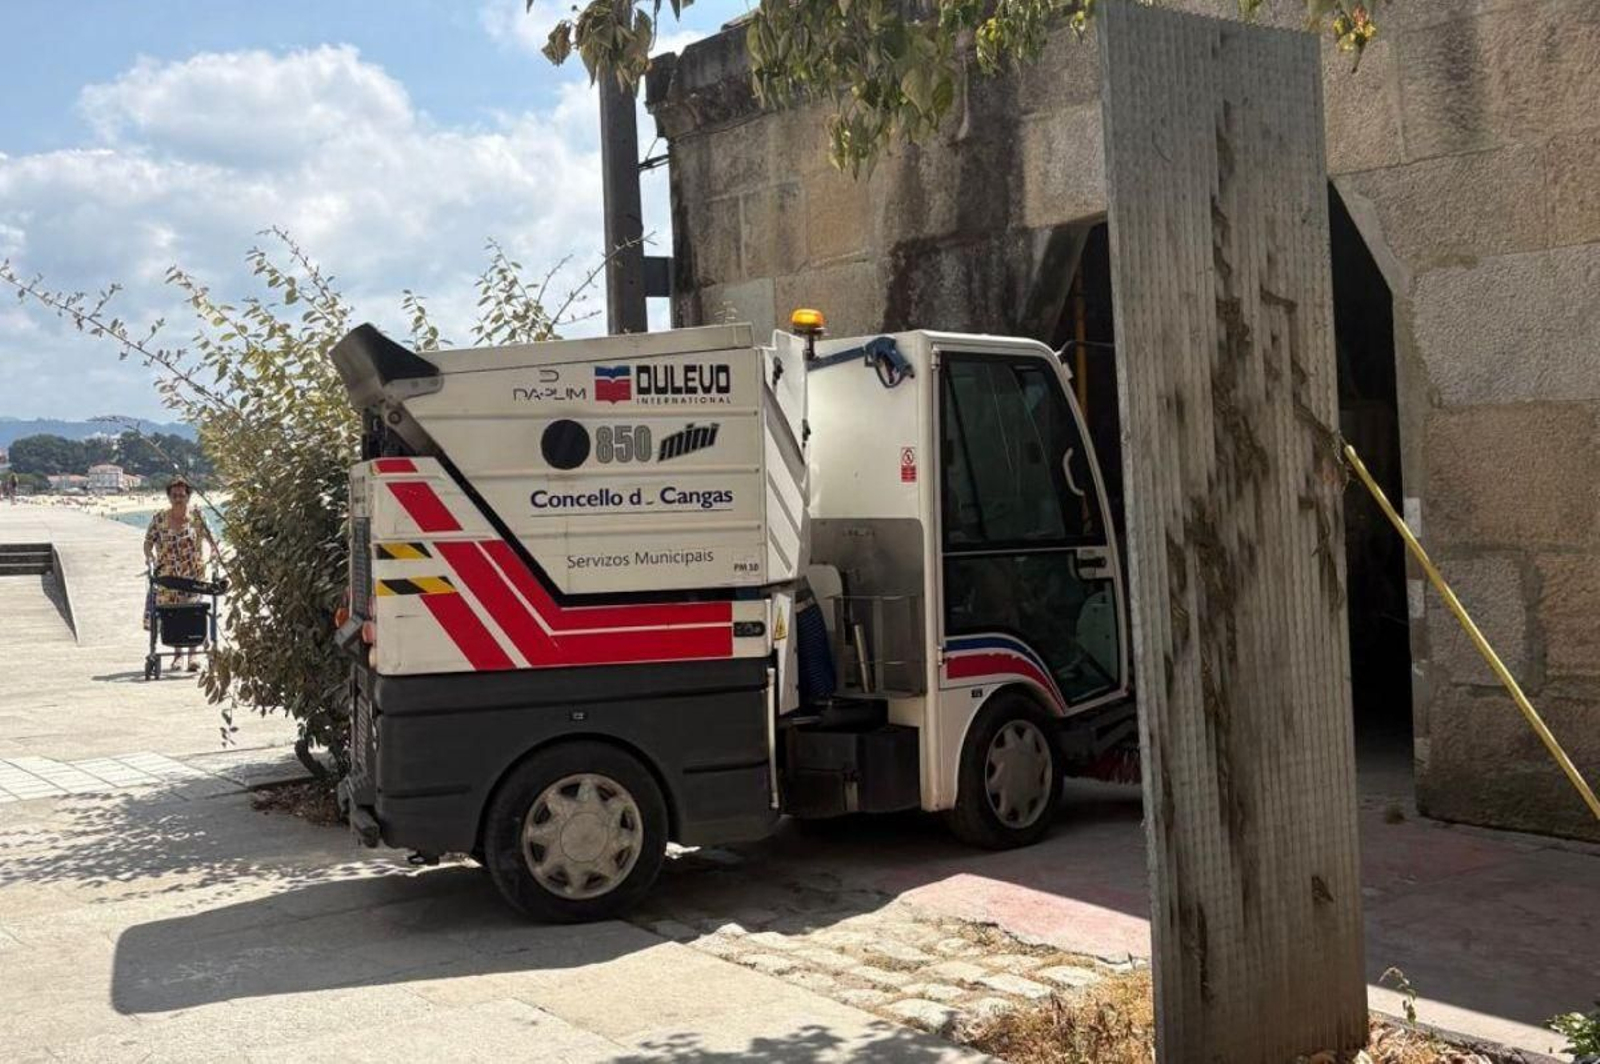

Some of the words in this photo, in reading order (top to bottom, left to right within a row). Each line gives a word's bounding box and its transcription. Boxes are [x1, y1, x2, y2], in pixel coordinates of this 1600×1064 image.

[636, 364, 731, 395] DULEVO
[636, 396, 731, 406] INTERNATIONAL
[596, 425, 652, 463] 850
[657, 422, 720, 463] mini
[530, 488, 624, 509] Concello
[629, 488, 655, 506] d
[659, 486, 733, 508] Cangas
[567, 553, 630, 569] Servizos
[634, 549, 714, 566] Municipais
